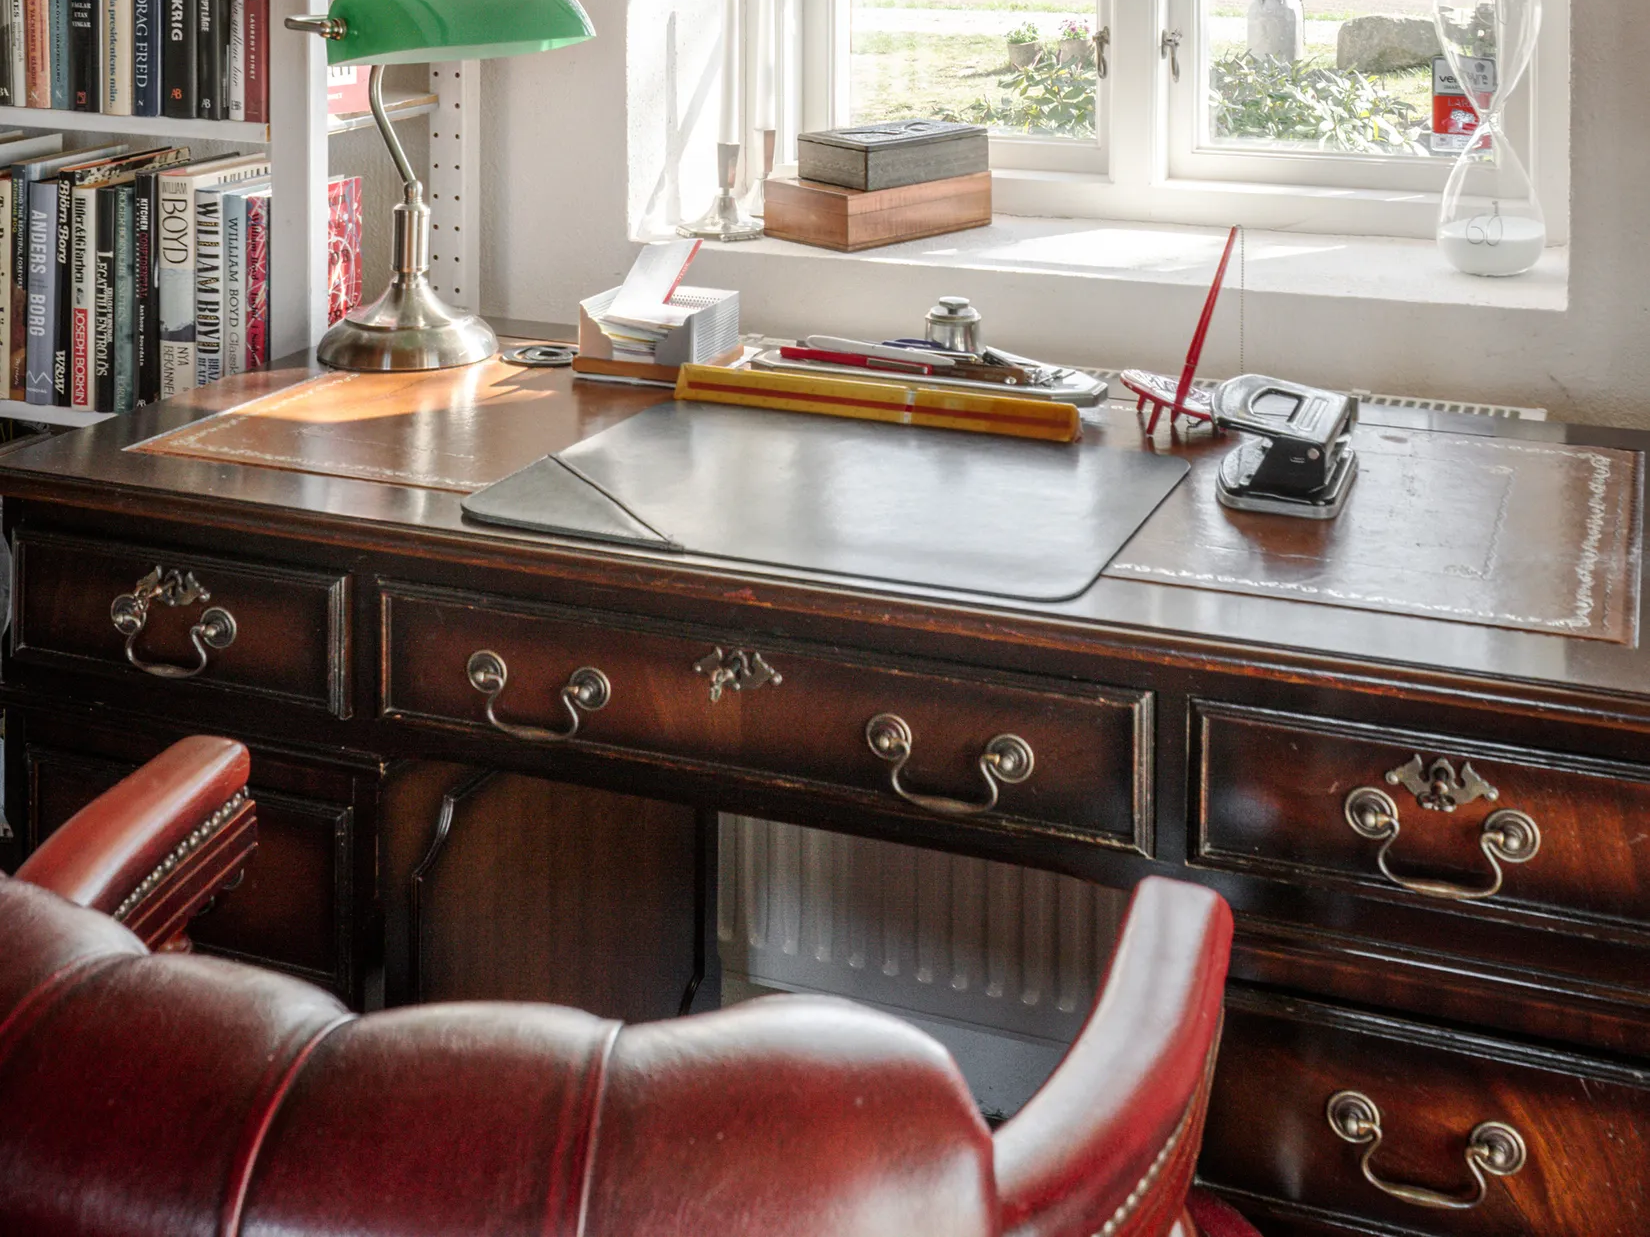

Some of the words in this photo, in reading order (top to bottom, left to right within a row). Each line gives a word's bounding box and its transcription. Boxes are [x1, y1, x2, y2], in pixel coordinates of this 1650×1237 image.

[108, 9, 118, 76] presidentens
[200, 12, 210, 33] LÄGE
[136, 41, 149, 88] FRED
[58, 179, 71, 224] Björn
[118, 189, 131, 225] ROGER
[161, 181, 187, 194] WILLIAM
[139, 198, 149, 231] KITCHEN
[162, 197, 188, 264] BOYD
[250, 213, 260, 252] William
[31, 210, 47, 274] ANDERS
[57, 225, 70, 265] Borg
[196, 201, 220, 294] WILLIAM
[228, 216, 239, 283] WILLIAM
[74, 247, 87, 284] Farben
[96, 250, 114, 289] LEGAT
[139, 232, 149, 299] CONFIDENTIAL
[250, 256, 259, 281] Boyd
[29, 293, 46, 337] BORG
[96, 315, 107, 333] EN
[196, 299, 221, 354] BOYD
[228, 288, 239, 328] BOYD
[75, 309, 86, 356] JOSEPH
[54, 350, 67, 395] W&W
[95, 333, 109, 377] TROLÖS
[177, 346, 189, 366] NYA
[75, 357, 86, 403] BORKIN
